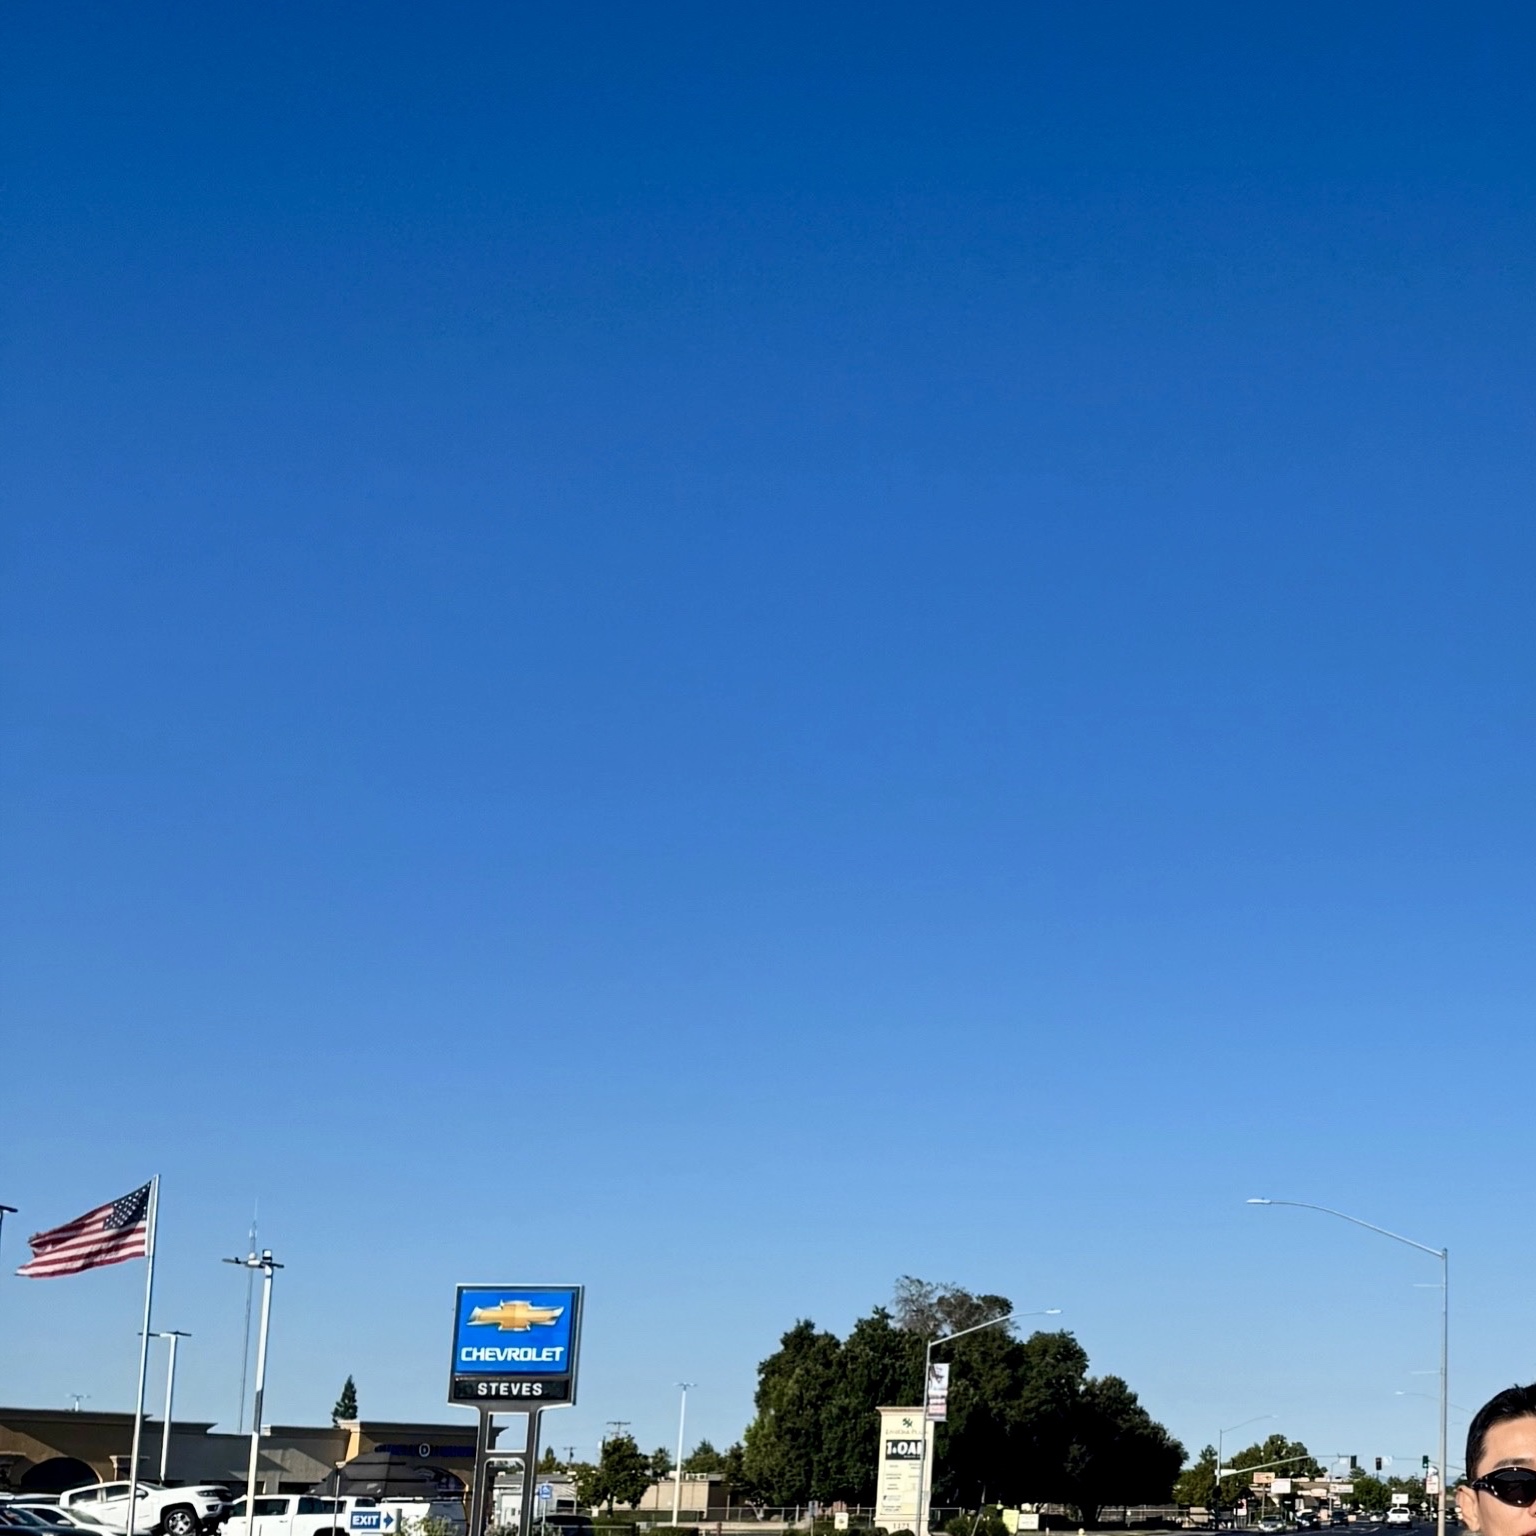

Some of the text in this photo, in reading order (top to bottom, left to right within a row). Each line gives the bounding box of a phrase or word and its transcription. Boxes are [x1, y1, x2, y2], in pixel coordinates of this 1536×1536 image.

[460, 1346, 565, 1362] CHEVROLET
[477, 1382, 543, 1396] STEVES
[352, 1514, 379, 1526] EXIT
